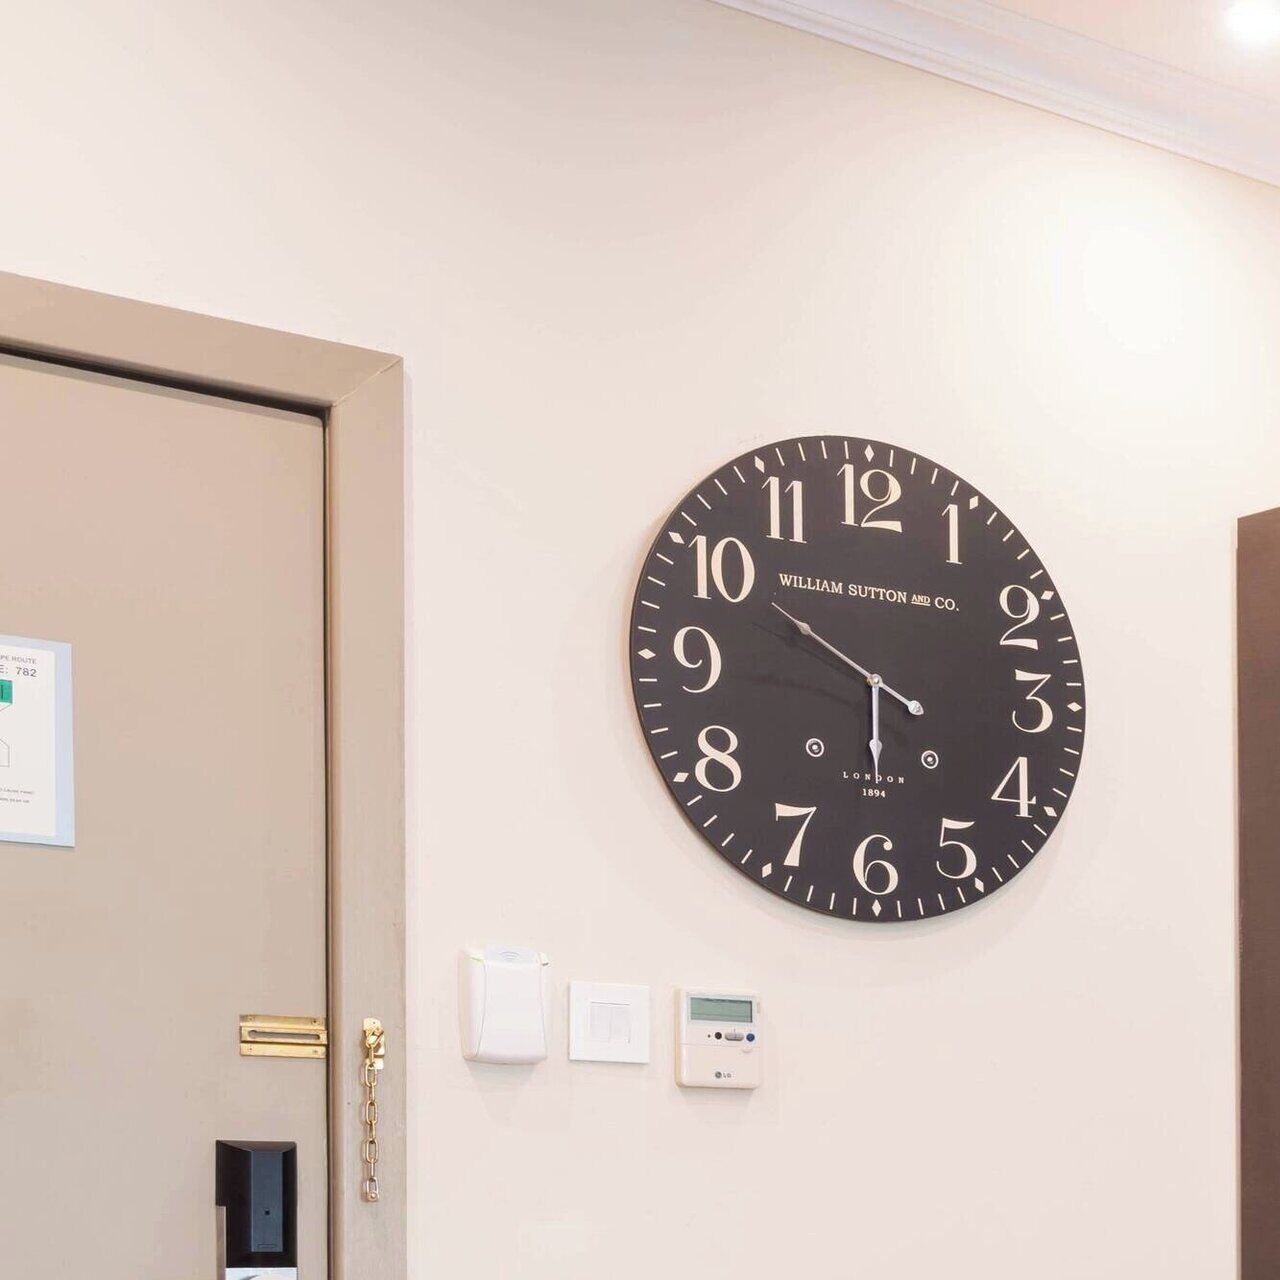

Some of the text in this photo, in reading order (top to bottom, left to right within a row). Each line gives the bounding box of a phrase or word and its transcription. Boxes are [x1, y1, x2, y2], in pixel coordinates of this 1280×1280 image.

[761, 475, 807, 544] 11
[836, 463, 903, 532] 12
[941, 503, 962, 565] 1
[688, 535, 755, 603] 10
[779, 573, 960, 612] WILLIAM SUTTON AND CO.
[999, 584, 1040, 650] 2
[16, 666, 37, 677] 782
[673, 626, 722, 693] 9
[1011, 668, 1053, 733] 3
[694, 725, 742, 792] 8
[843, 771, 905, 784] LONDON
[990, 756, 1037, 818] 4
[862, 788, 886, 798] 1894
[774, 802, 817, 867] 7
[852, 834, 898, 895] 6
[935, 817, 977, 879] 5
